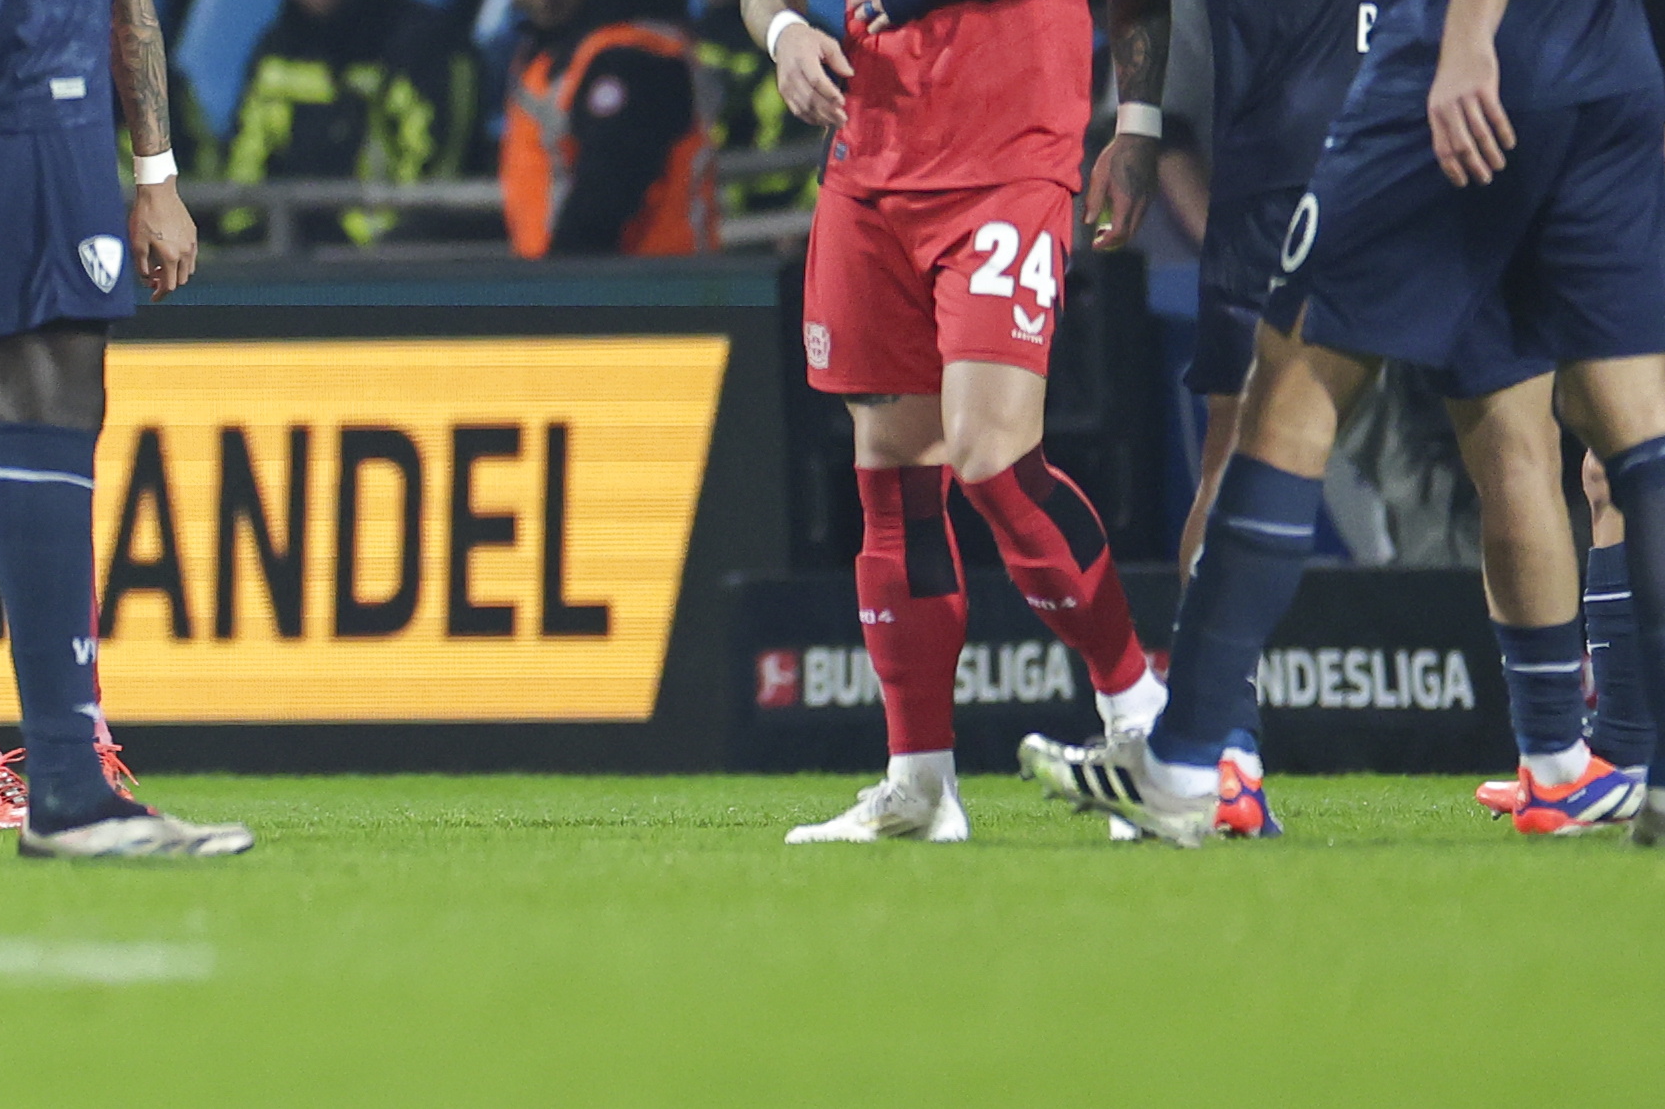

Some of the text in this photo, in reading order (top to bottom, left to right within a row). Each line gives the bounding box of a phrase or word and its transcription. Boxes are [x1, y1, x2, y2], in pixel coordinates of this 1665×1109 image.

[970, 221, 1057, 308] 24
[804, 644, 1476, 710] BUSLIGA NDESLIGA
